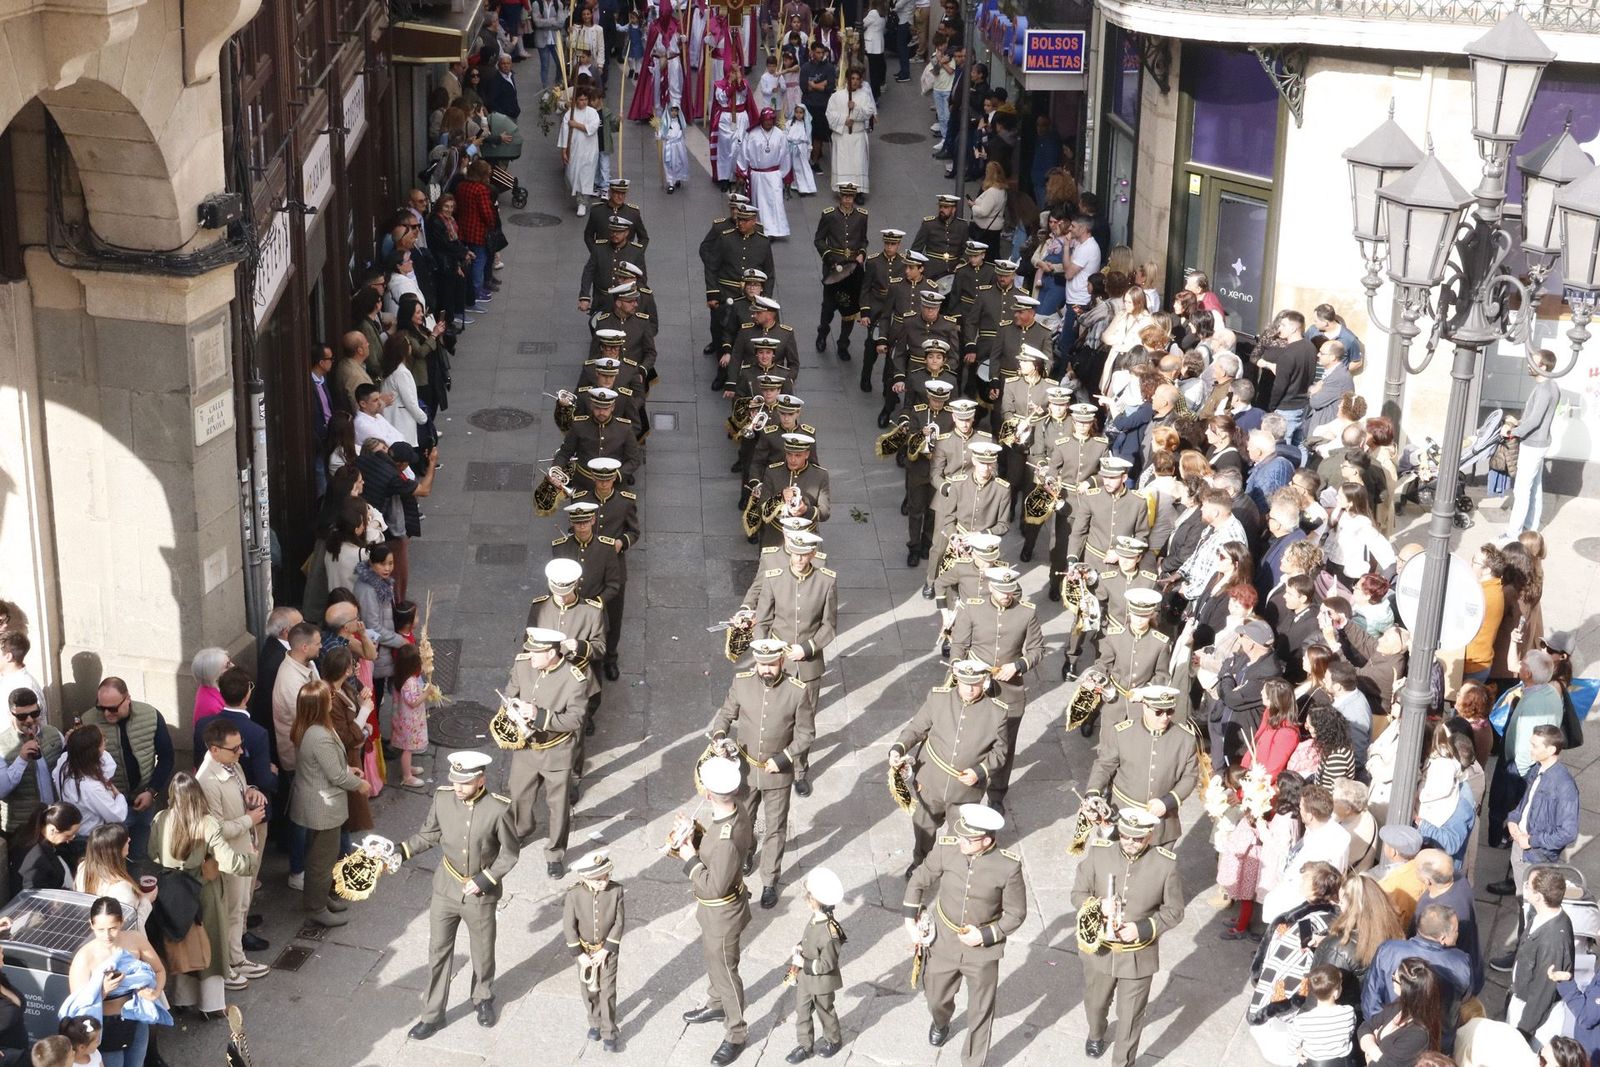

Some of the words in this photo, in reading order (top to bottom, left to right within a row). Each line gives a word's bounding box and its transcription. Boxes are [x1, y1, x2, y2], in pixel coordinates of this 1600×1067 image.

[1031, 37, 1079, 50] BOLSOS
[1027, 55, 1081, 68] MALETAS
[208, 399, 225, 414] CALLE
[207, 414, 214, 426] DE
[216, 410, 224, 420] LA
[26, 1001, 55, 1011] ESIDUOS
